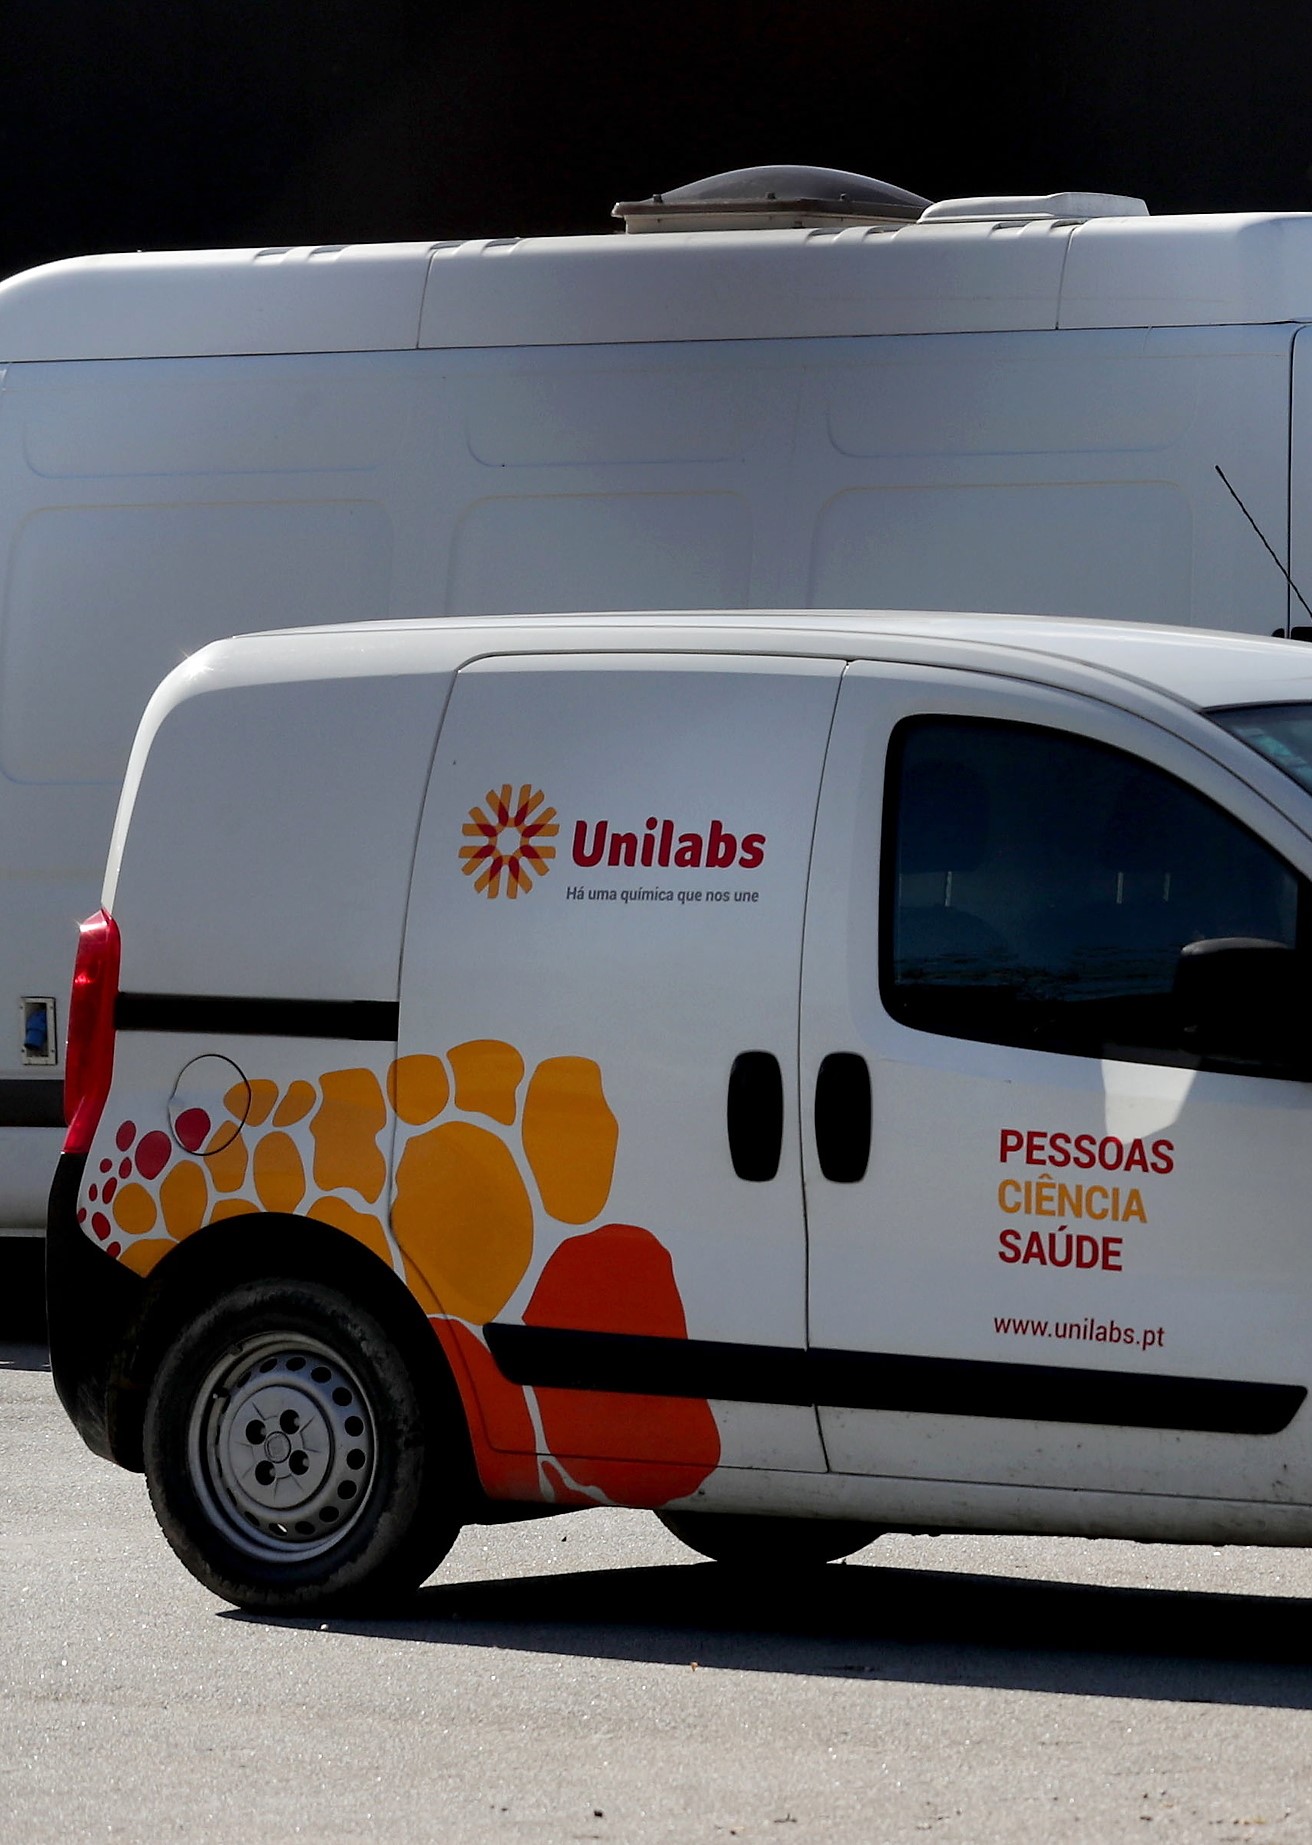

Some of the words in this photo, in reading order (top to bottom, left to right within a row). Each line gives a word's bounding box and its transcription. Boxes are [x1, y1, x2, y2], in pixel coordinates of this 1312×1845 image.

[572, 816, 767, 869] Unilabs
[566, 886, 585, 901] Há
[588, 890, 617, 902] uma
[620, 886, 674, 904] química
[676, 890, 703, 905] que
[705, 890, 730, 902] nos
[734, 891, 760, 903] une
[1000, 1129, 1174, 1175] PESSOAS
[998, 1173, 1148, 1224] CIÊNCIA
[998, 1225, 1123, 1272] SAÚDE
[994, 1317, 1165, 1351] www.unilabs.pt
